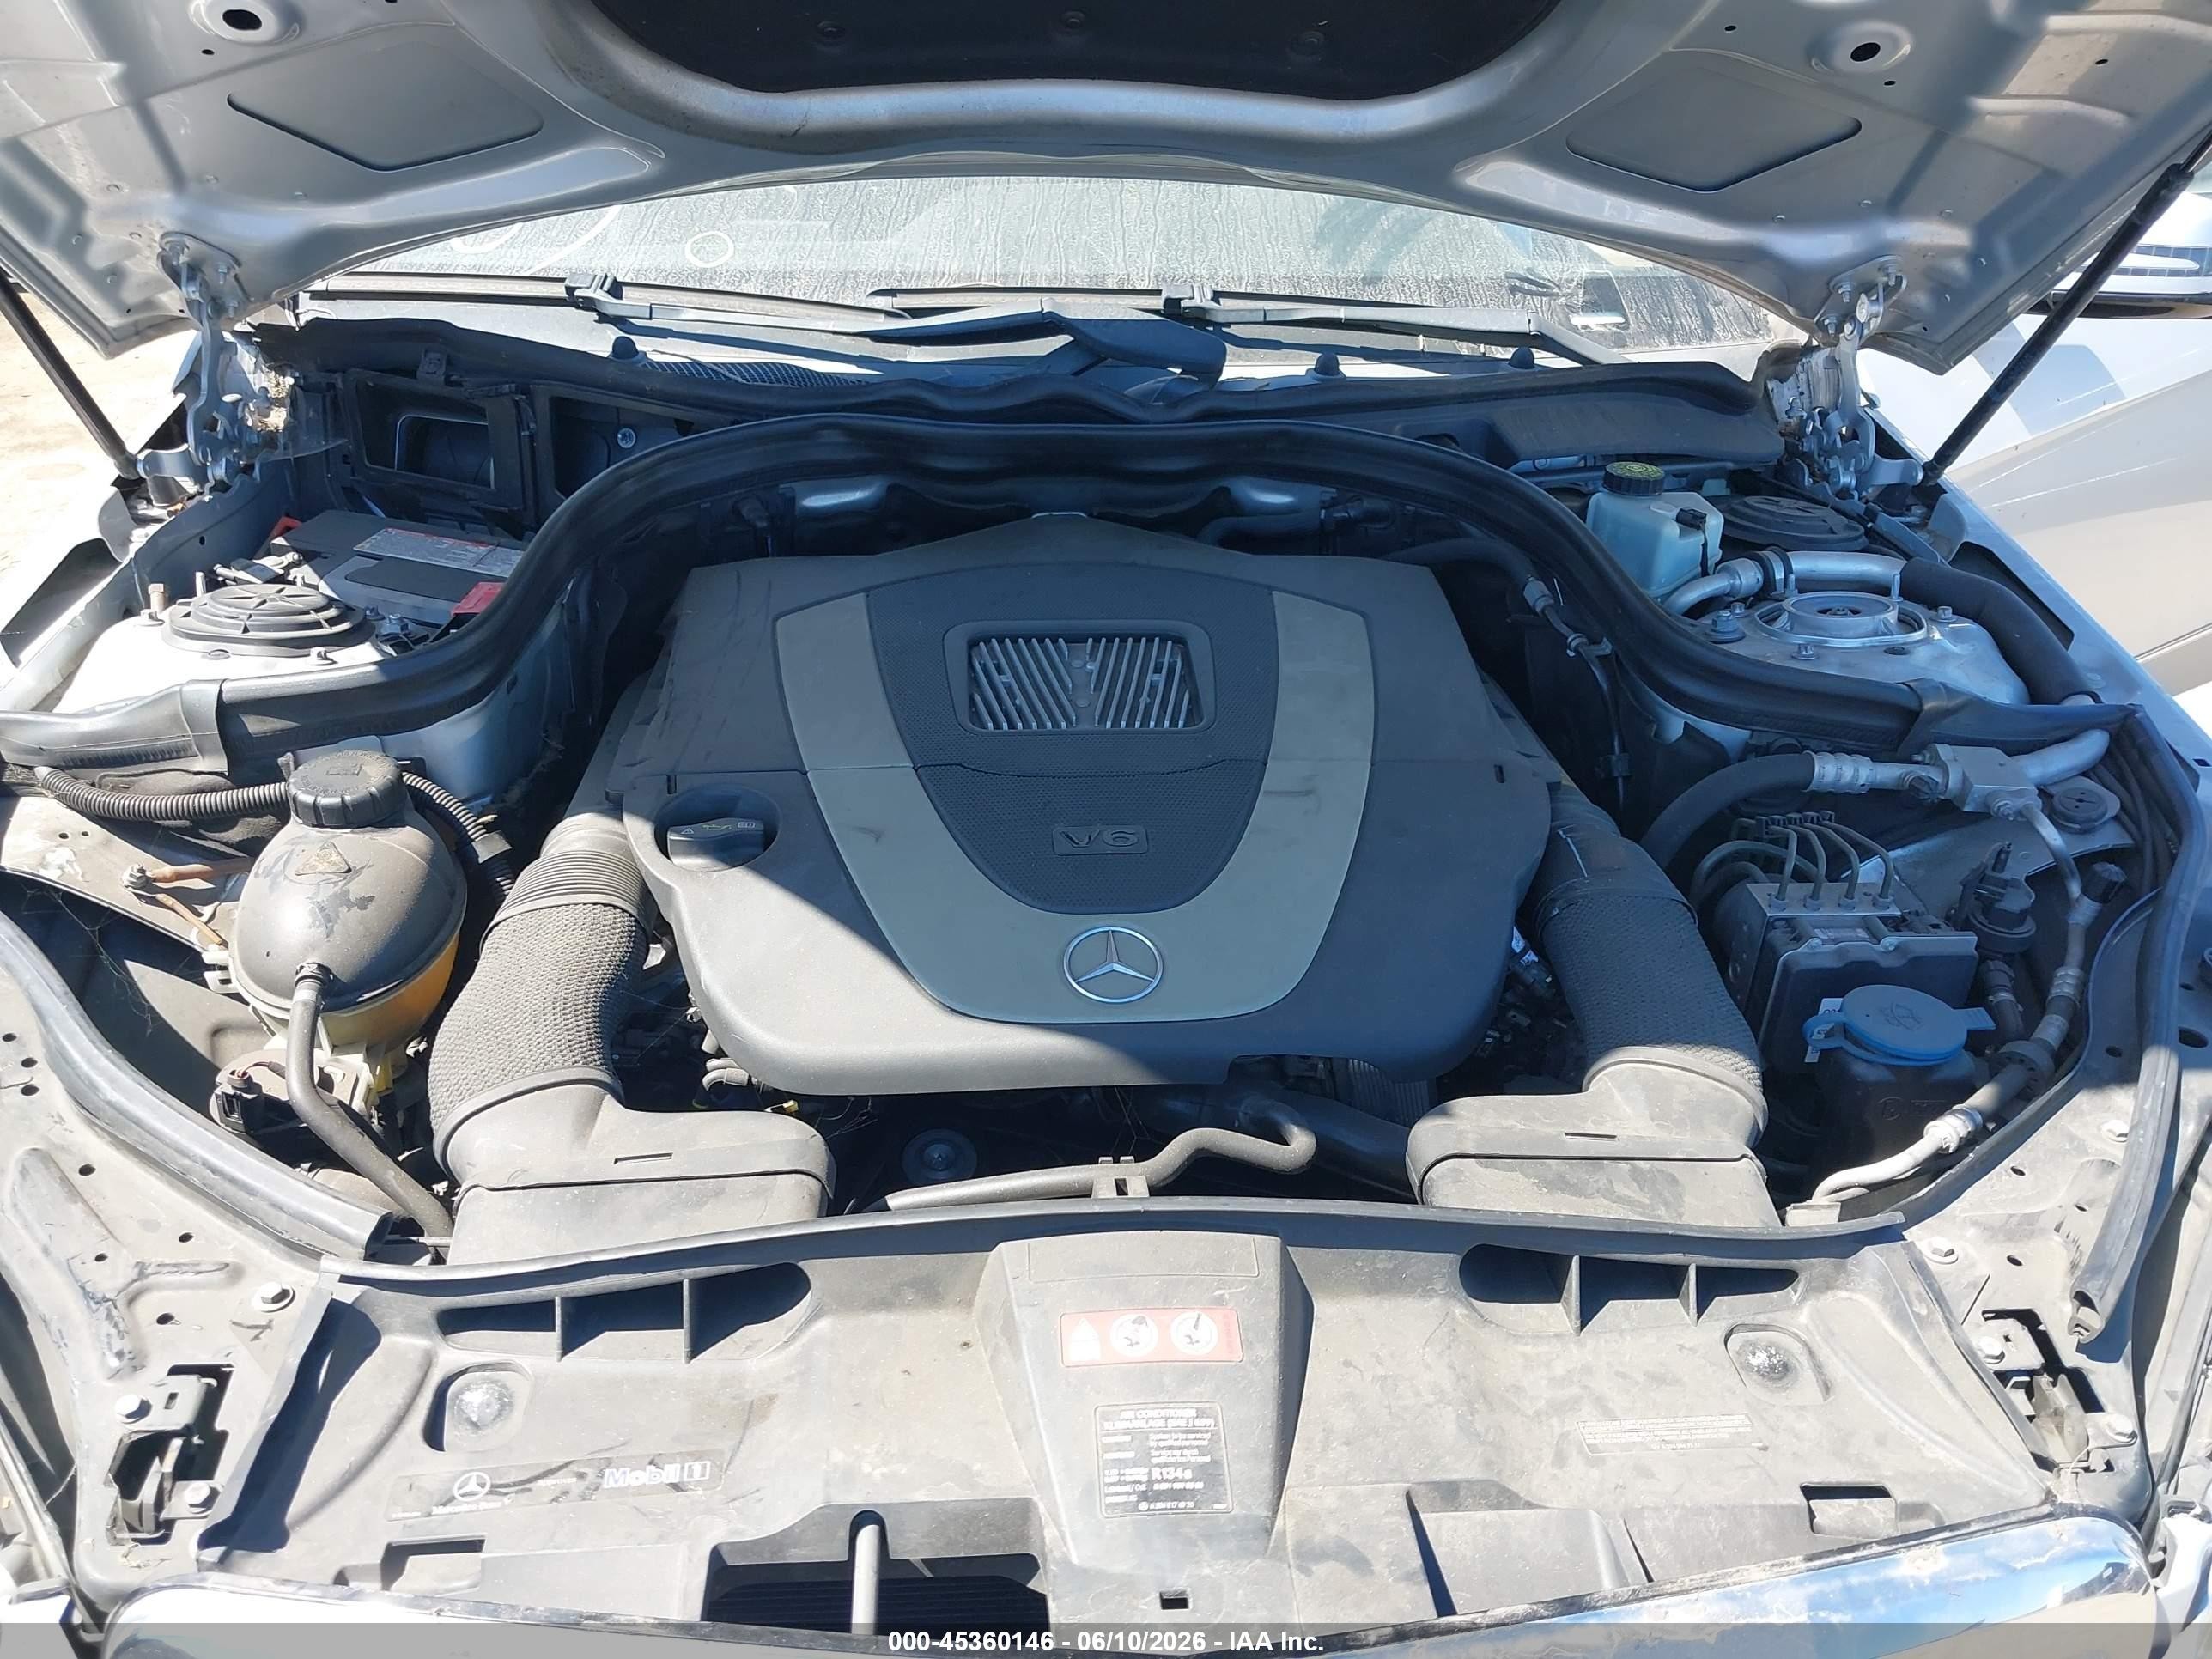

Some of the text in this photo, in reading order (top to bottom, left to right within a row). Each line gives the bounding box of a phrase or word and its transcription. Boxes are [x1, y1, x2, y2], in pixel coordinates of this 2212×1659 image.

[1059, 829, 1139, 848] V6
[603, 1463, 680, 1489] Mobil
[1152, 1467, 1193, 1480] R134a
